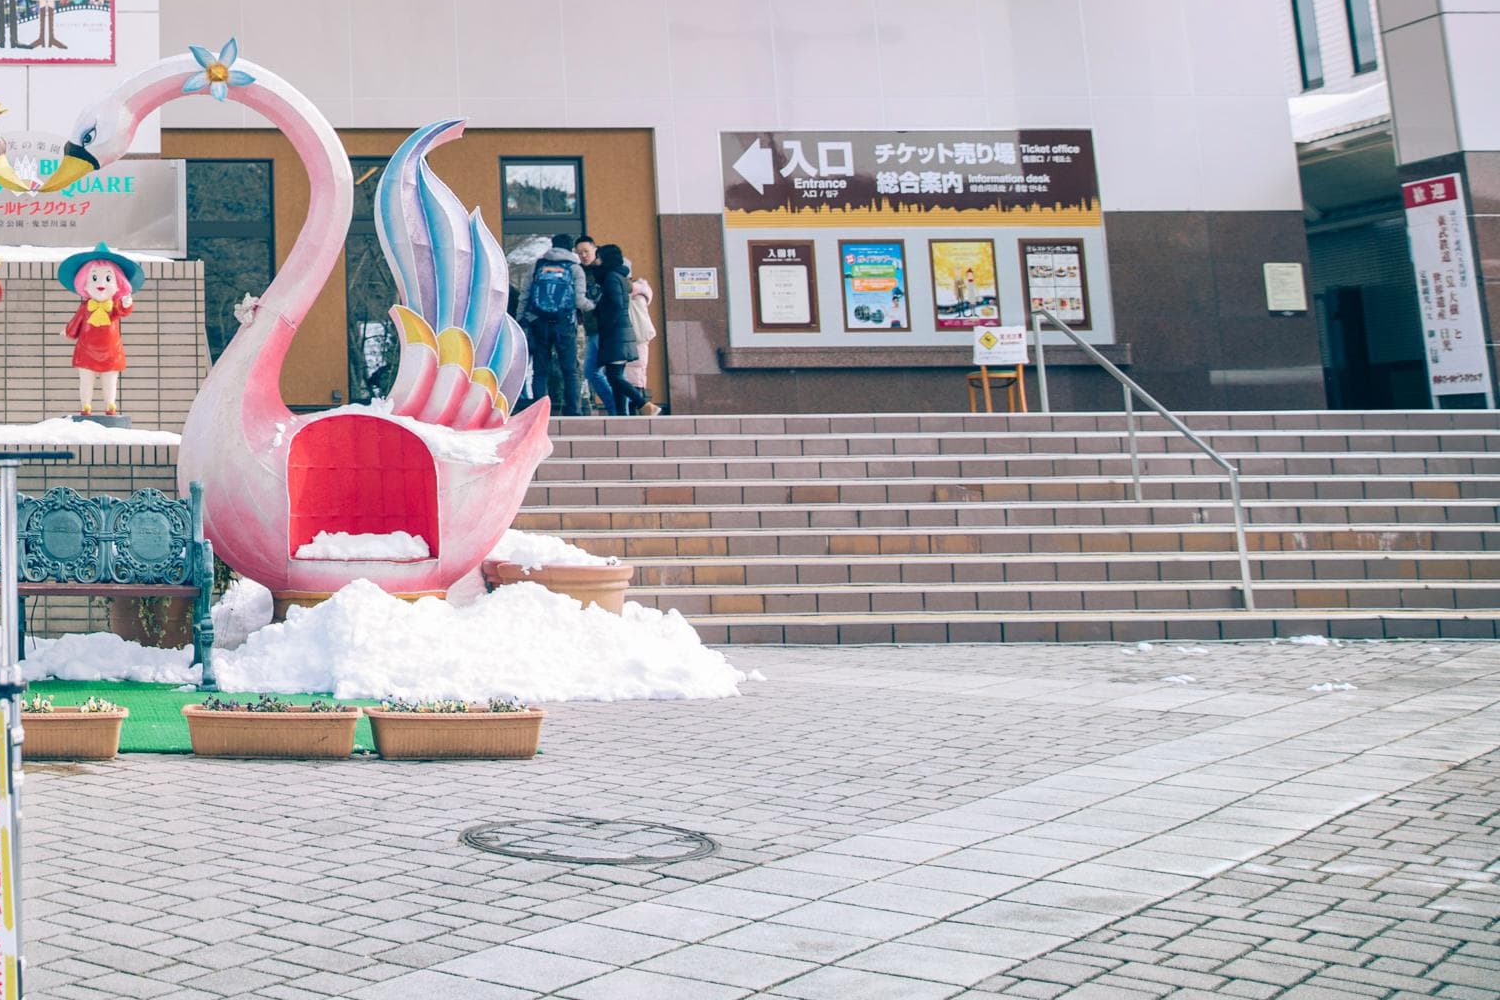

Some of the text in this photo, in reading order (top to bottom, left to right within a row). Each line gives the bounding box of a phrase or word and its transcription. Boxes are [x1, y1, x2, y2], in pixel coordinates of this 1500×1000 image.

[9, 140, 61, 154] 笑の楽園
[875, 142, 1016, 164] チケット売り場
[1020, 144, 1080, 154] Ticket office
[780, 141, 855, 177] 入口
[61, 176, 135, 198] QUARE
[794, 178, 847, 189] Entrance
[876, 171, 964, 194] 総合案内
[968, 173, 1051, 183] Information desk
